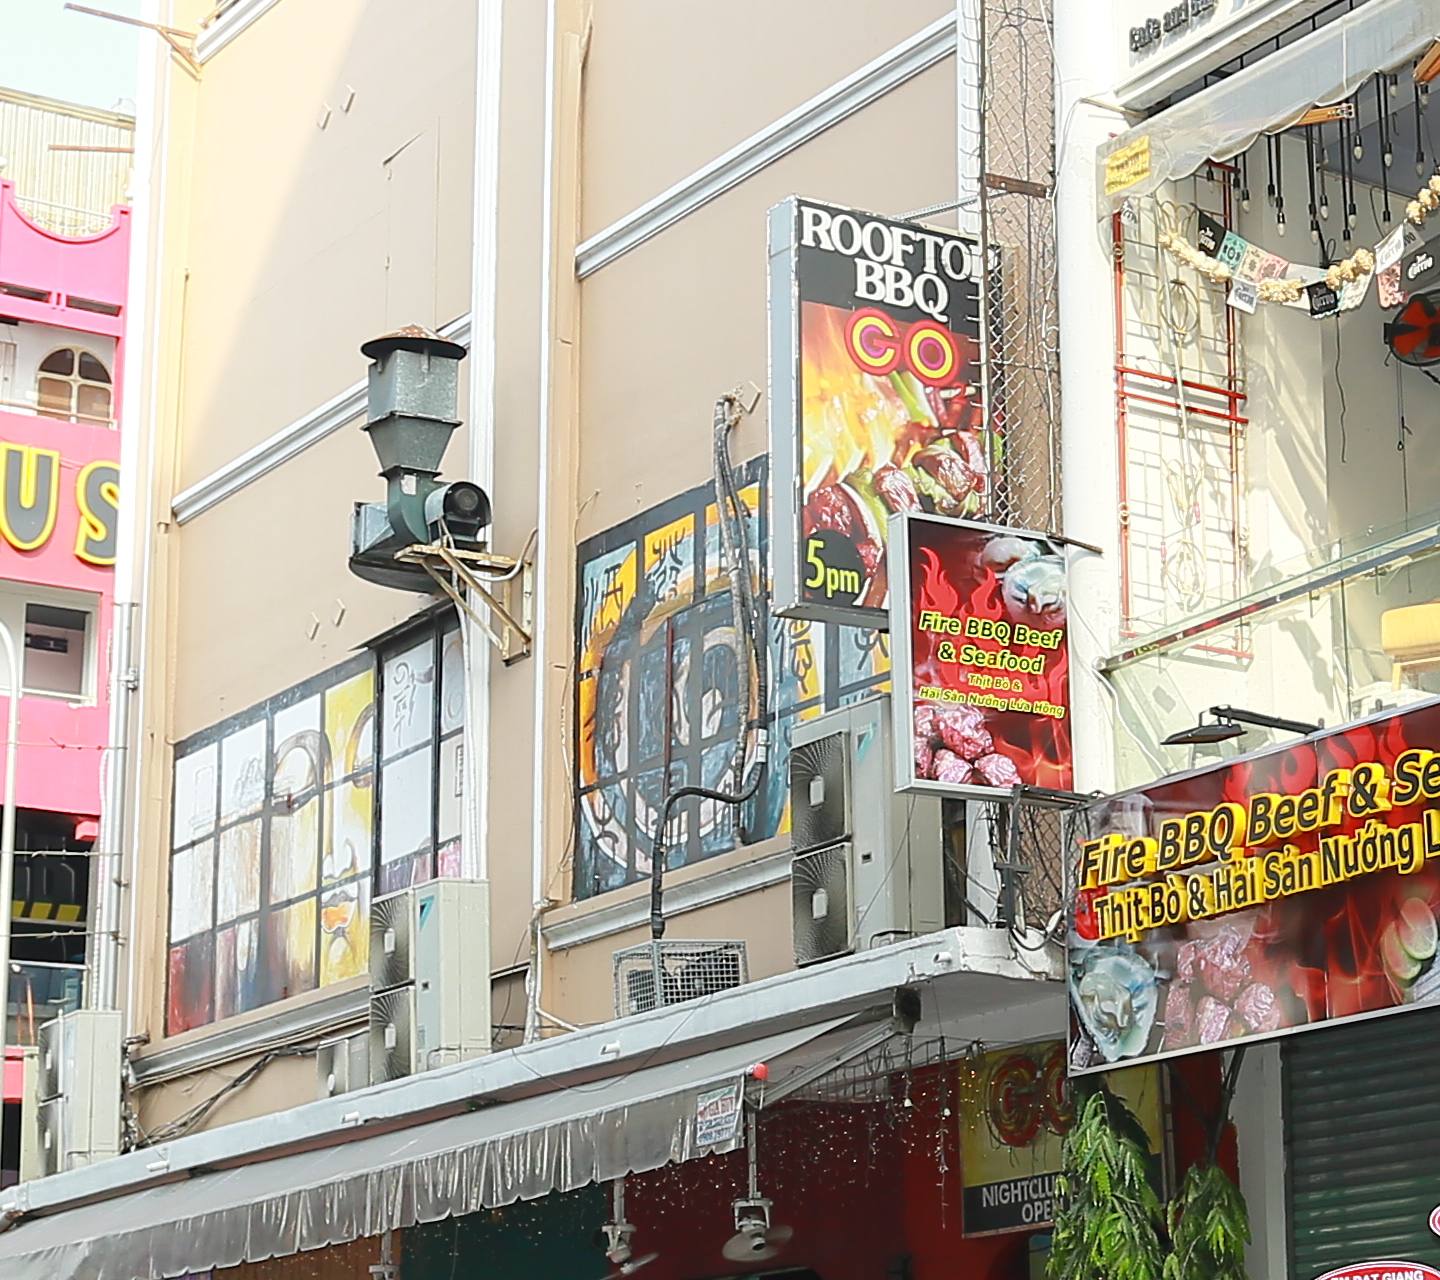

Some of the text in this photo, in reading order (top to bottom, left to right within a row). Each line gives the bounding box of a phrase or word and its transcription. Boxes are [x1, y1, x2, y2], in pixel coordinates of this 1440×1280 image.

[854, 257, 950, 322] BBQ
[844, 306, 960, 388] GO
[805, 539, 860, 595] 5pm
[919, 610, 1063, 649] Fire BBQ Beef
[938, 641, 1046, 674] & Seafood
[1012, 681, 1023, 692] &
[1079, 833, 1154, 891] Fire
[1157, 802, 1244, 870] BBQ
[1247, 770, 1350, 844] Beef
[1348, 764, 1390, 817] &
[1094, 890, 1148, 943] Thịt
[1147, 880, 1185, 923] Bò
[1186, 874, 1212, 918] &
[1213, 854, 1261, 912] Hải
[1262, 845, 1322, 900] Sản
[1320, 818, 1425, 885] Nướng
